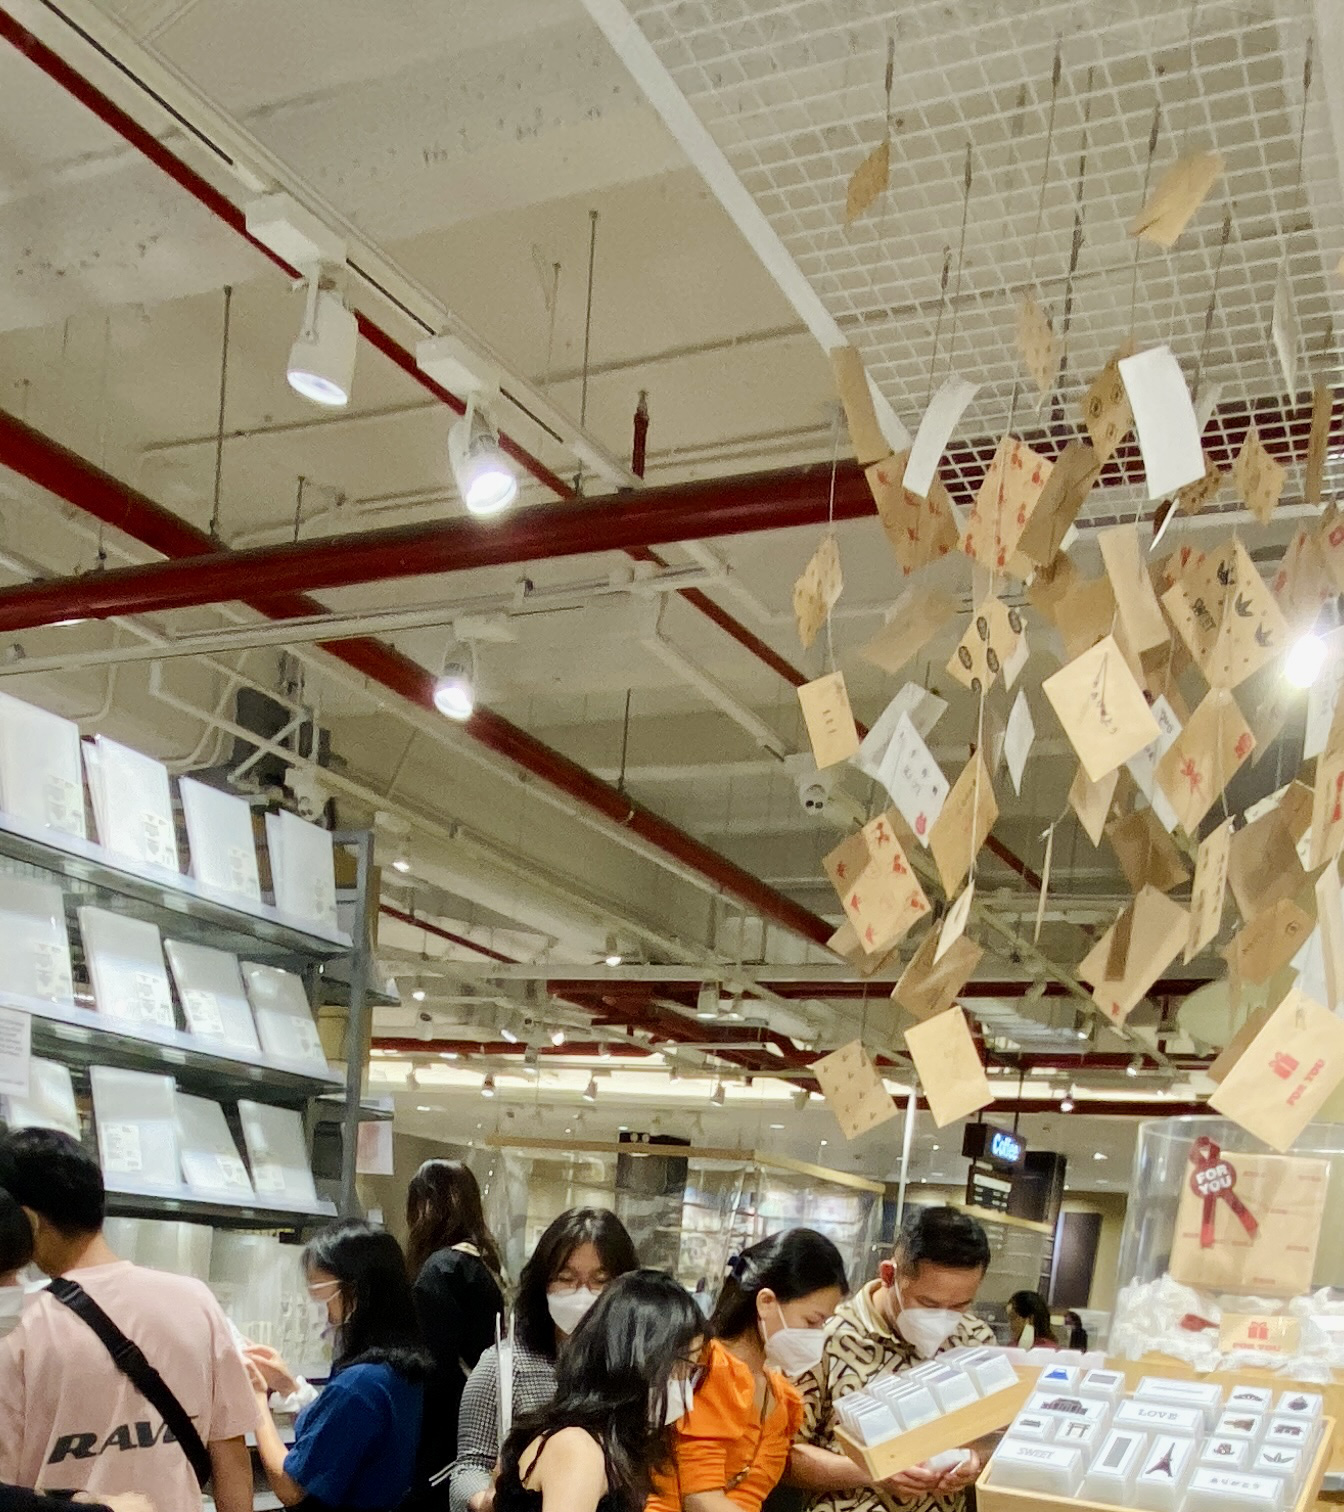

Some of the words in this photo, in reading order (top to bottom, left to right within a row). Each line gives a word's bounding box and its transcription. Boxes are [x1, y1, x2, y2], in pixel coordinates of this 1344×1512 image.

[1286, 1084, 1308, 1106] FOR
[1303, 1058, 1325, 1082] YOU
[992, 1132, 1020, 1162] Coffee
[1195, 1164, 1228, 1185] FOR
[1198, 1175, 1233, 1195] YOU
[1138, 1408, 1178, 1420] LOVE
[47, 1415, 199, 1464] RAV
[1016, 1447, 1056, 1459] SWEET
